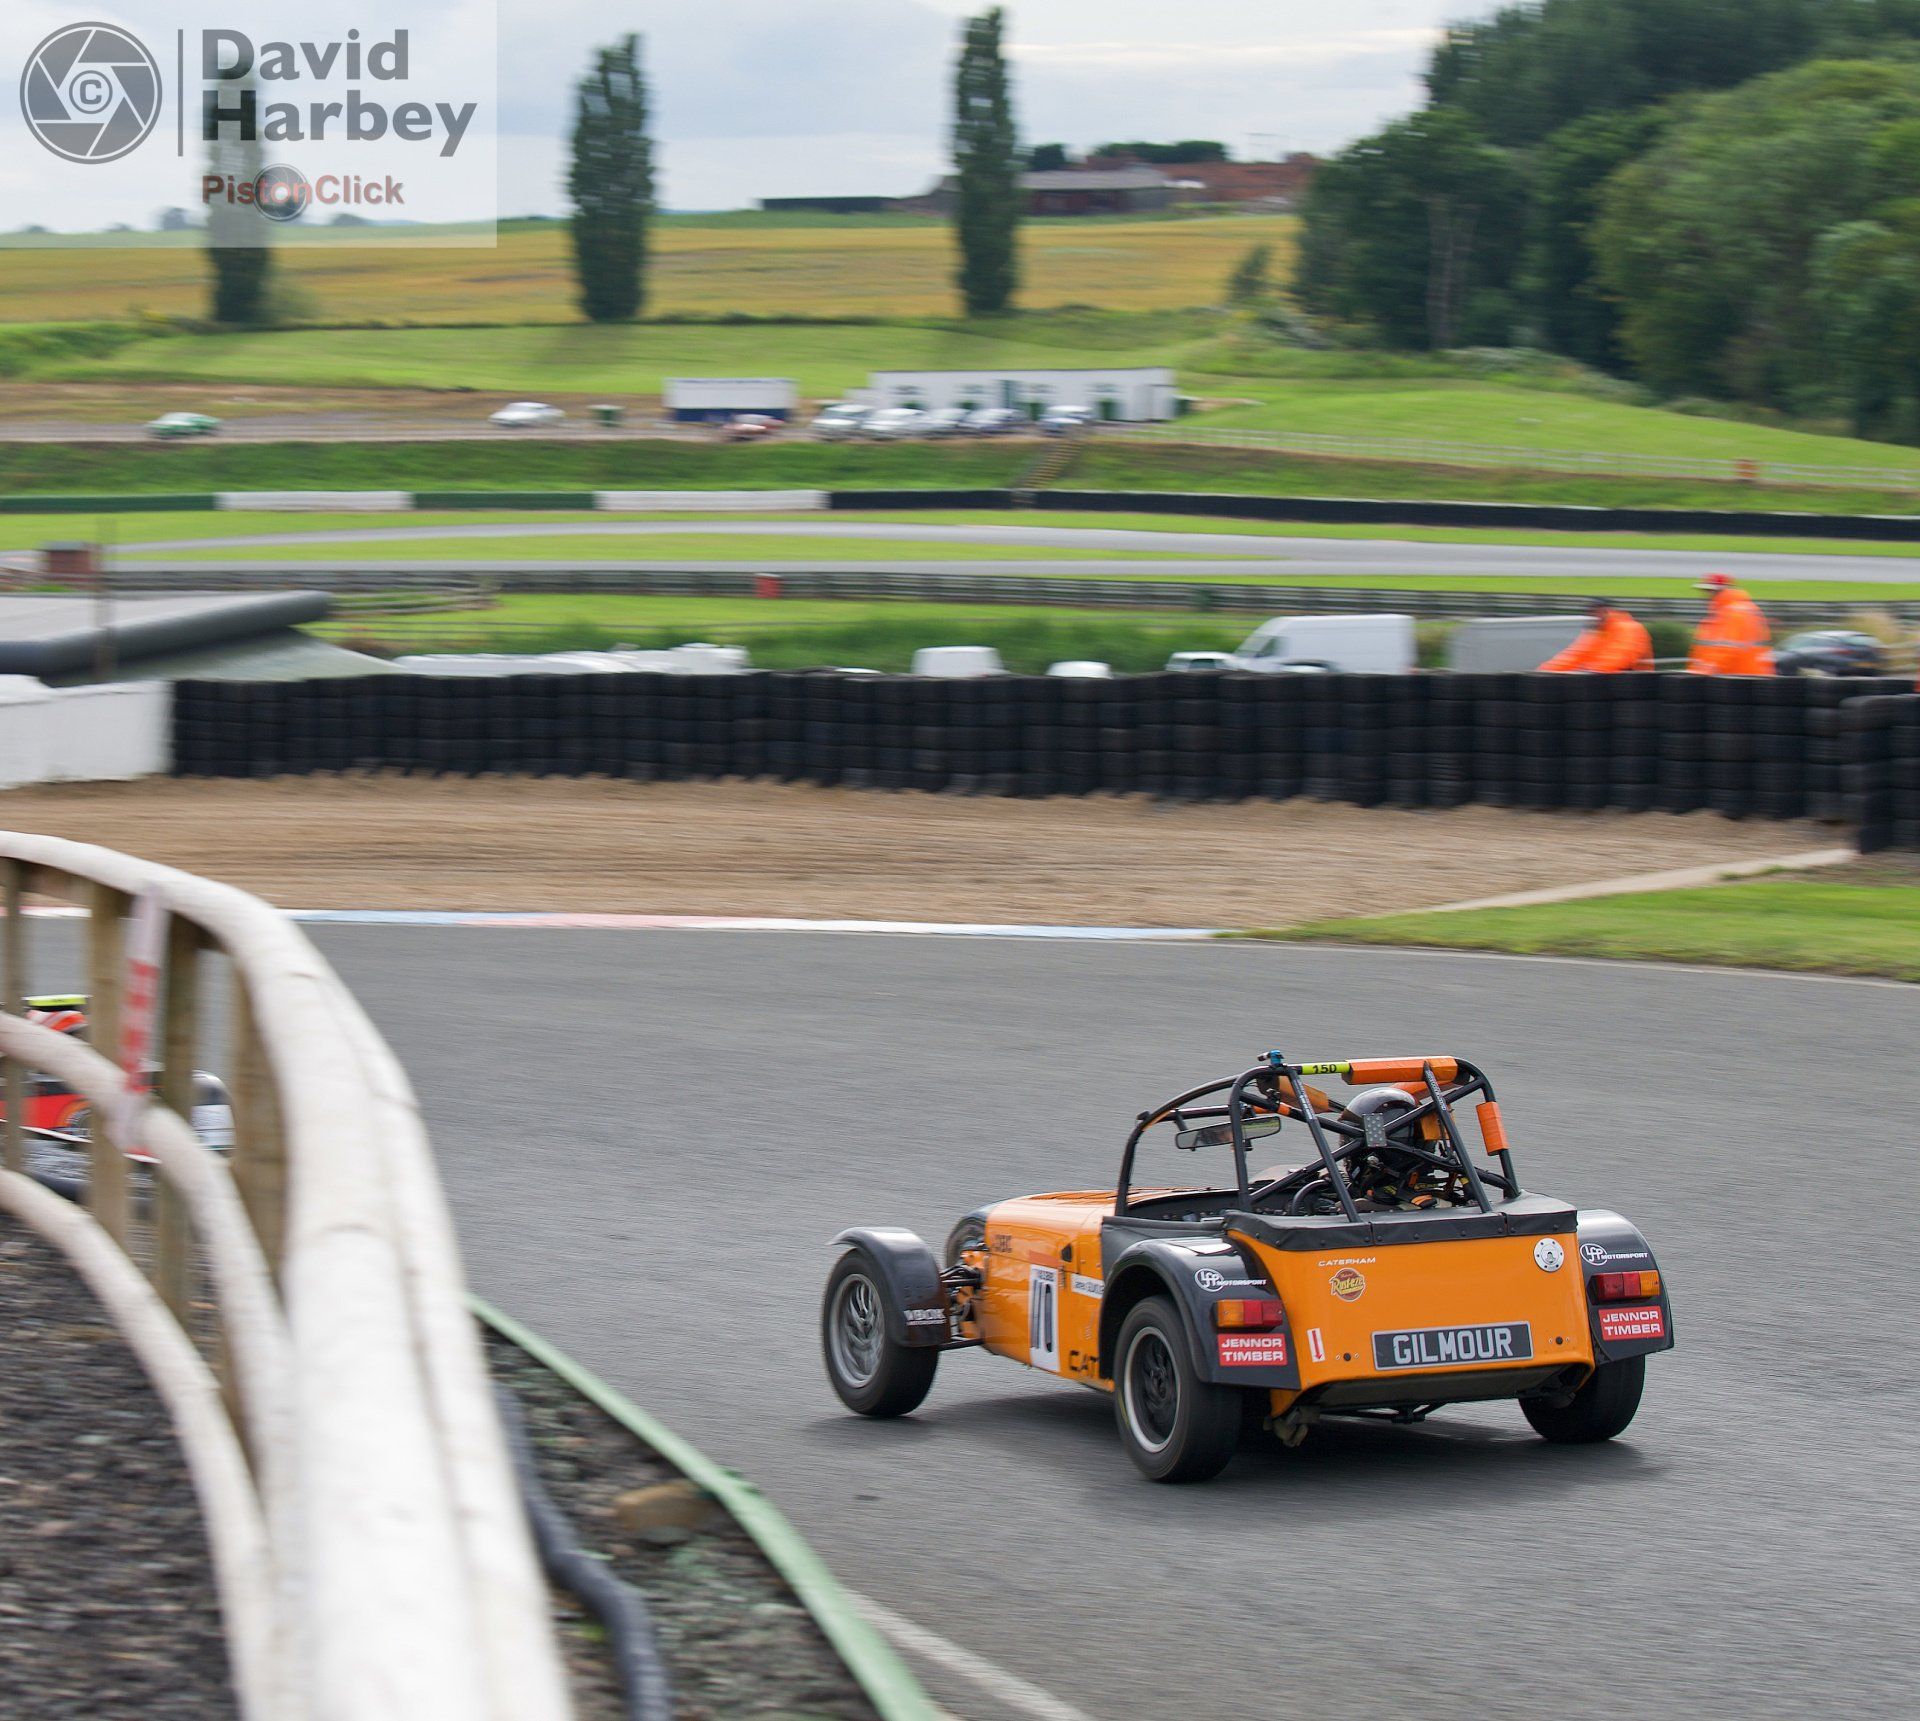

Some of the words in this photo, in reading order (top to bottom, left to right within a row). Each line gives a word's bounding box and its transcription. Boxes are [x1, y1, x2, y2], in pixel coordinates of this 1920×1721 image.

[1312, 1064, 1337, 1075] 150
[1318, 1256, 1376, 1267] CATERHAM
[1601, 1252, 1648, 1260] MOTORSPORT
[1603, 1310, 1659, 1323] JENNOR
[1604, 1323, 1661, 1336] TIMBER
[1221, 1338, 1282, 1348] JENNOR
[1392, 1327, 1514, 1365] GILMOUR
[1222, 1350, 1284, 1362] TIMBER
